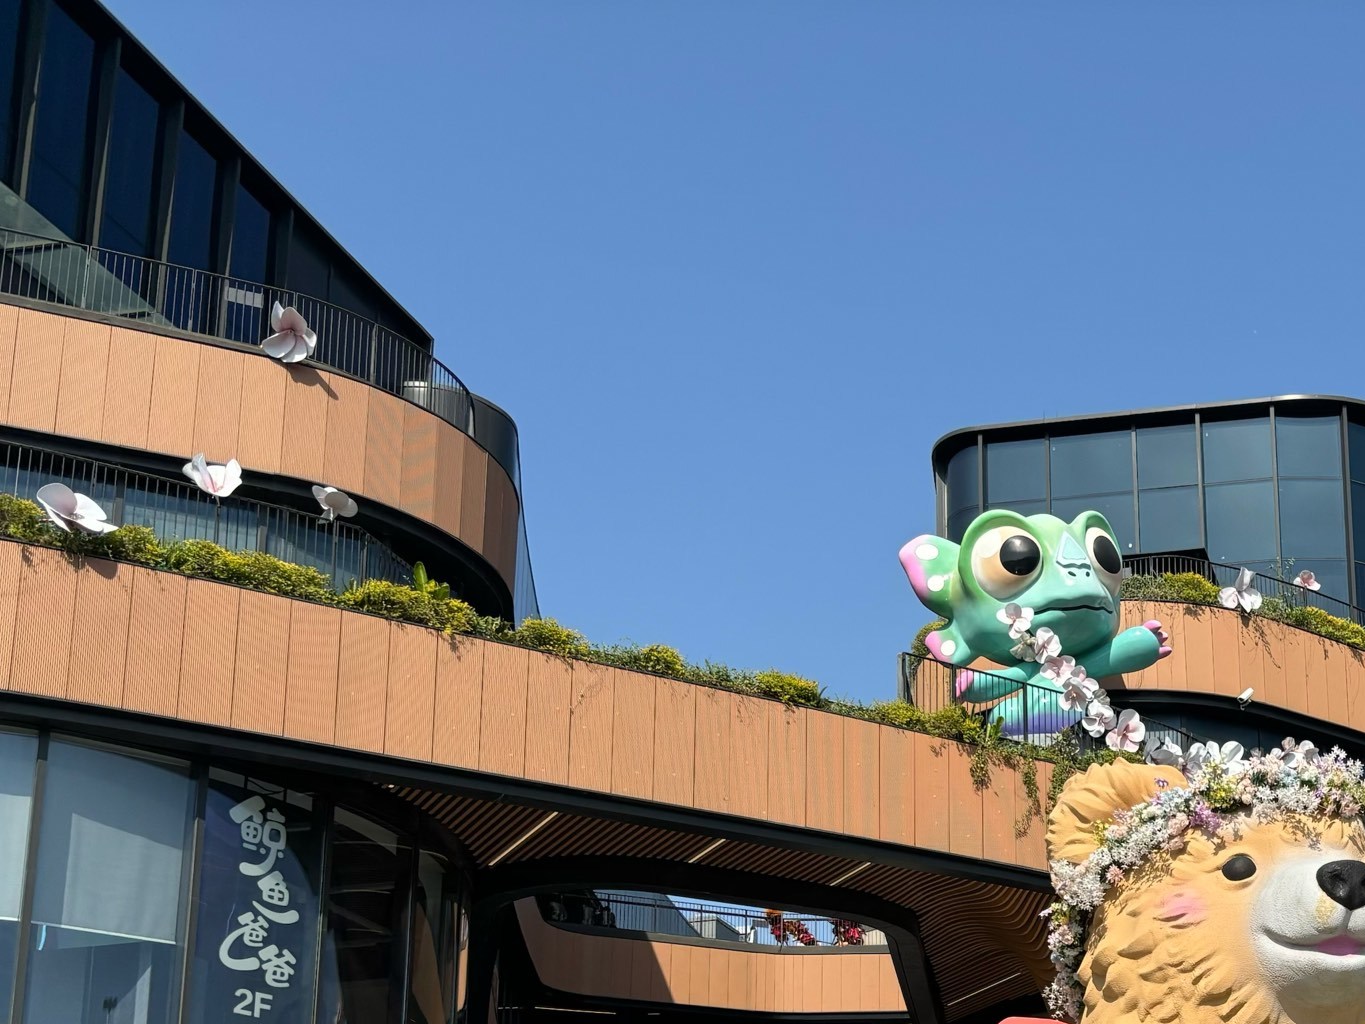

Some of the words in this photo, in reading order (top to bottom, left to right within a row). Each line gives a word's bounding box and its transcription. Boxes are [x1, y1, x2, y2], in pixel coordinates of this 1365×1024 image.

[219, 796, 299, 988] 鲸鱼爸爸
[233, 988, 273, 1019] 2F
